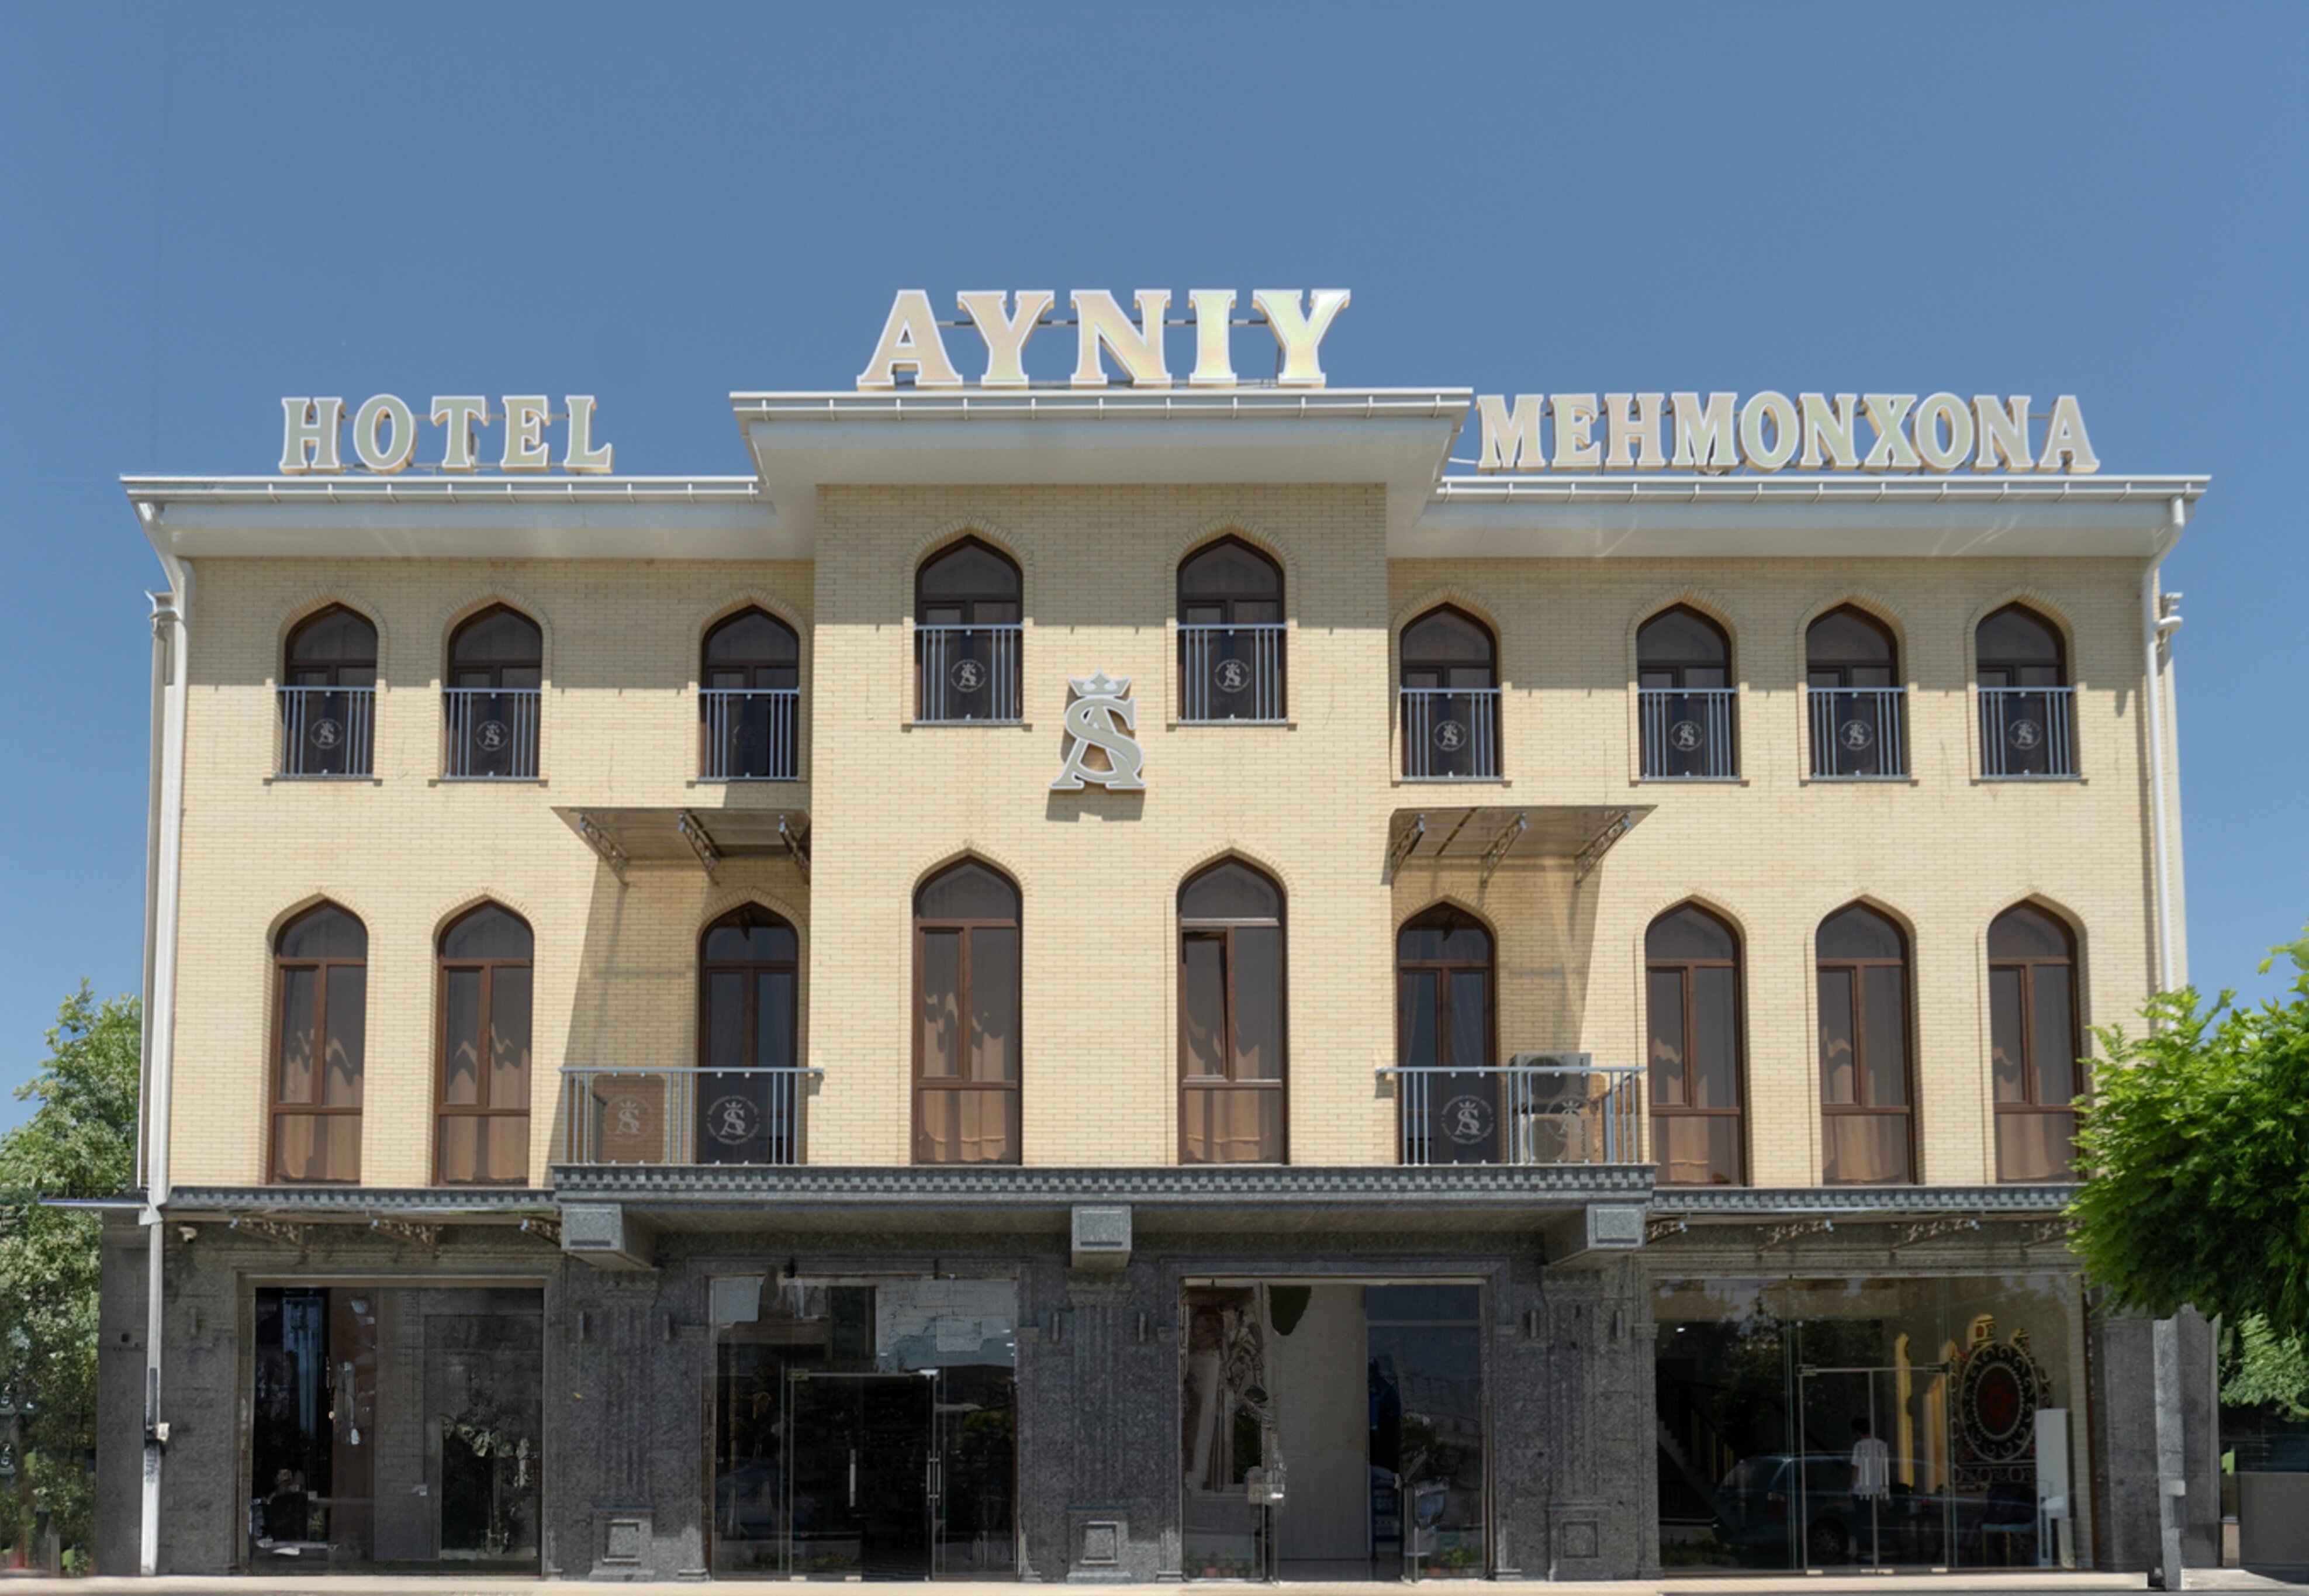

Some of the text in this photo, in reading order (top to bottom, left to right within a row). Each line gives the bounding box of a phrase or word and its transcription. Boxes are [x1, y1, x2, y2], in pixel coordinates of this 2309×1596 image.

[856, 289, 1351, 389] AYNIY
[278, 393, 613, 474] HOTEL
[1475, 391, 2100, 473] MEHMONXONA
